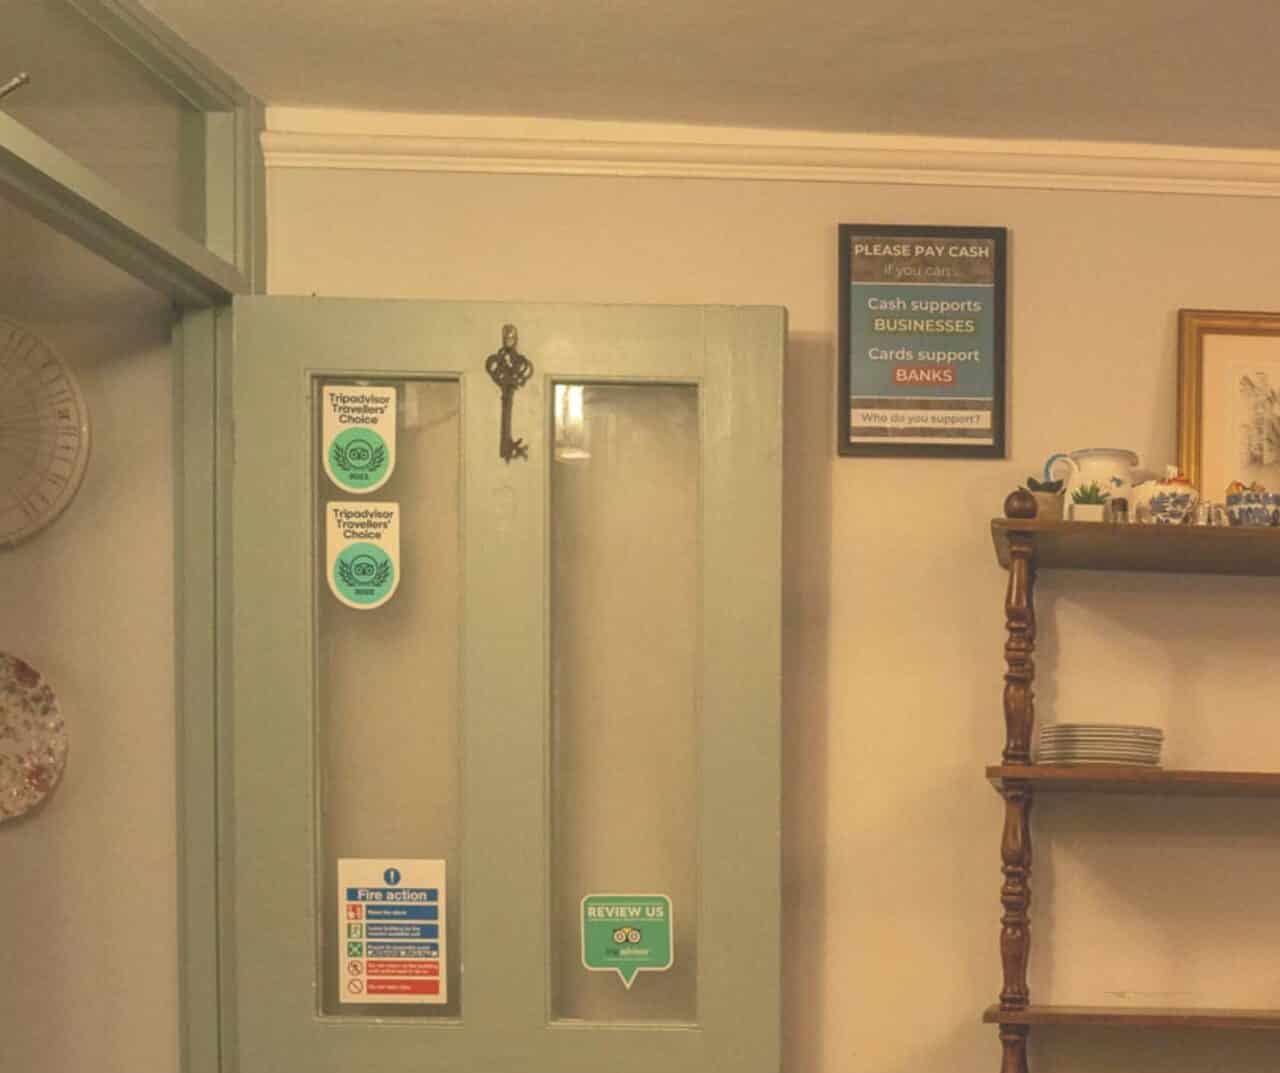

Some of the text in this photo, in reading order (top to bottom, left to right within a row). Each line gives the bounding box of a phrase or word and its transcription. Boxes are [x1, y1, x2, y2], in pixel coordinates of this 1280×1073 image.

[854, 244, 990, 259] PLEASE PAY CASH
[895, 266, 921, 278] you
[867, 297, 982, 314] Cash supports
[873, 318, 976, 333] BUSINESSES
[868, 347, 980, 364] Cards support
[895, 368, 953, 382] BANKS
[329, 393, 391, 405] Tripadvisor
[338, 414, 379, 424] Choice
[860, 412, 982, 427] Who do you support?
[333, 508, 394, 519] Tripadvisor
[343, 529, 382, 539] Choice
[357, 888, 428, 900] Fire action
[588, 906, 664, 917] REVIEW US
